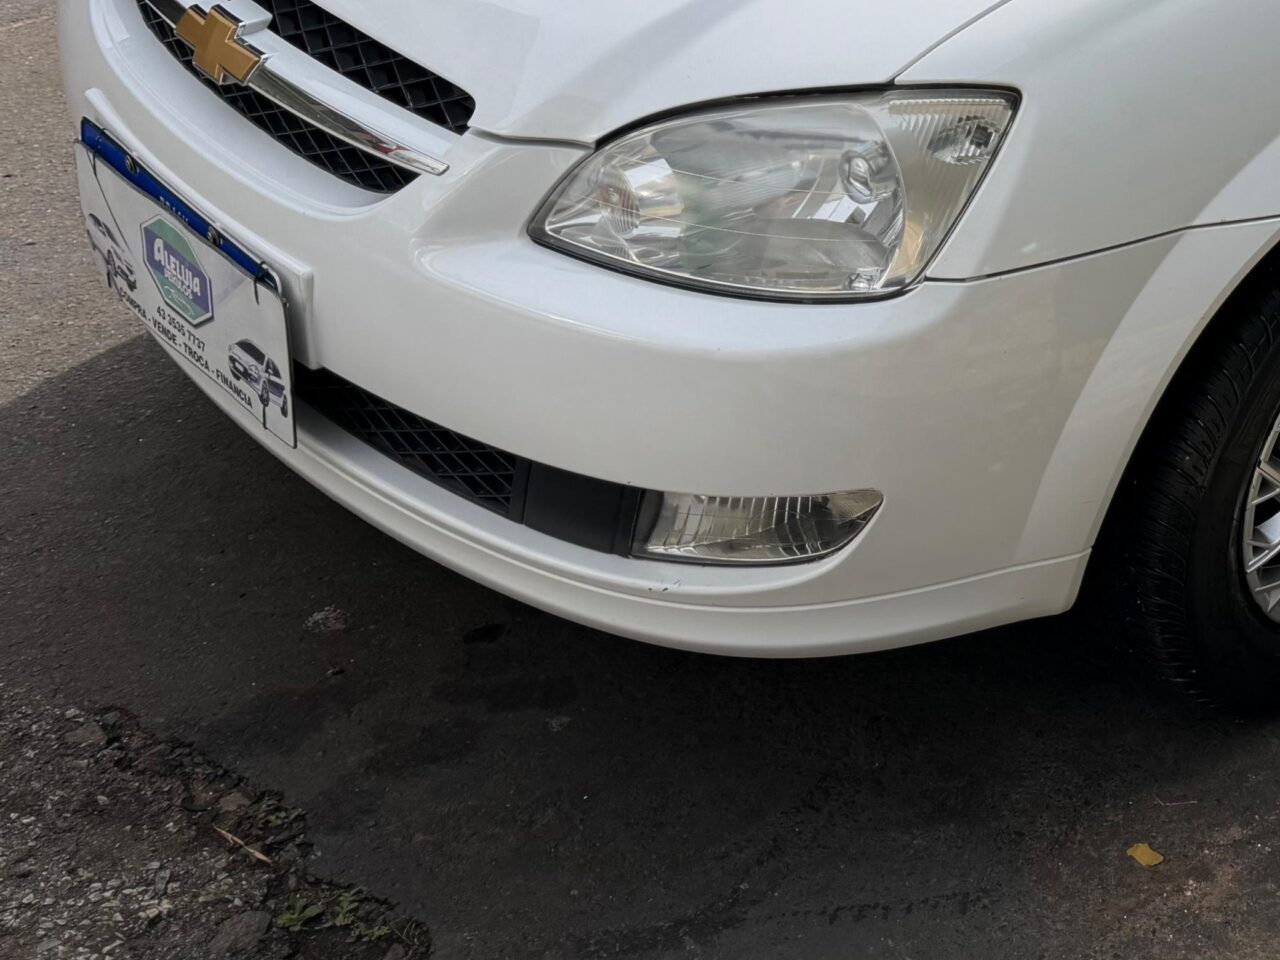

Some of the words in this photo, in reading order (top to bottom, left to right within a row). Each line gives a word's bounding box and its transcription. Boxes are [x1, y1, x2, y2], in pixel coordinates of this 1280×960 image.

[152, 317, 178, 347] VENDE
[183, 342, 210, 373] TROCA
[216, 368, 253, 409] FINANCIA
